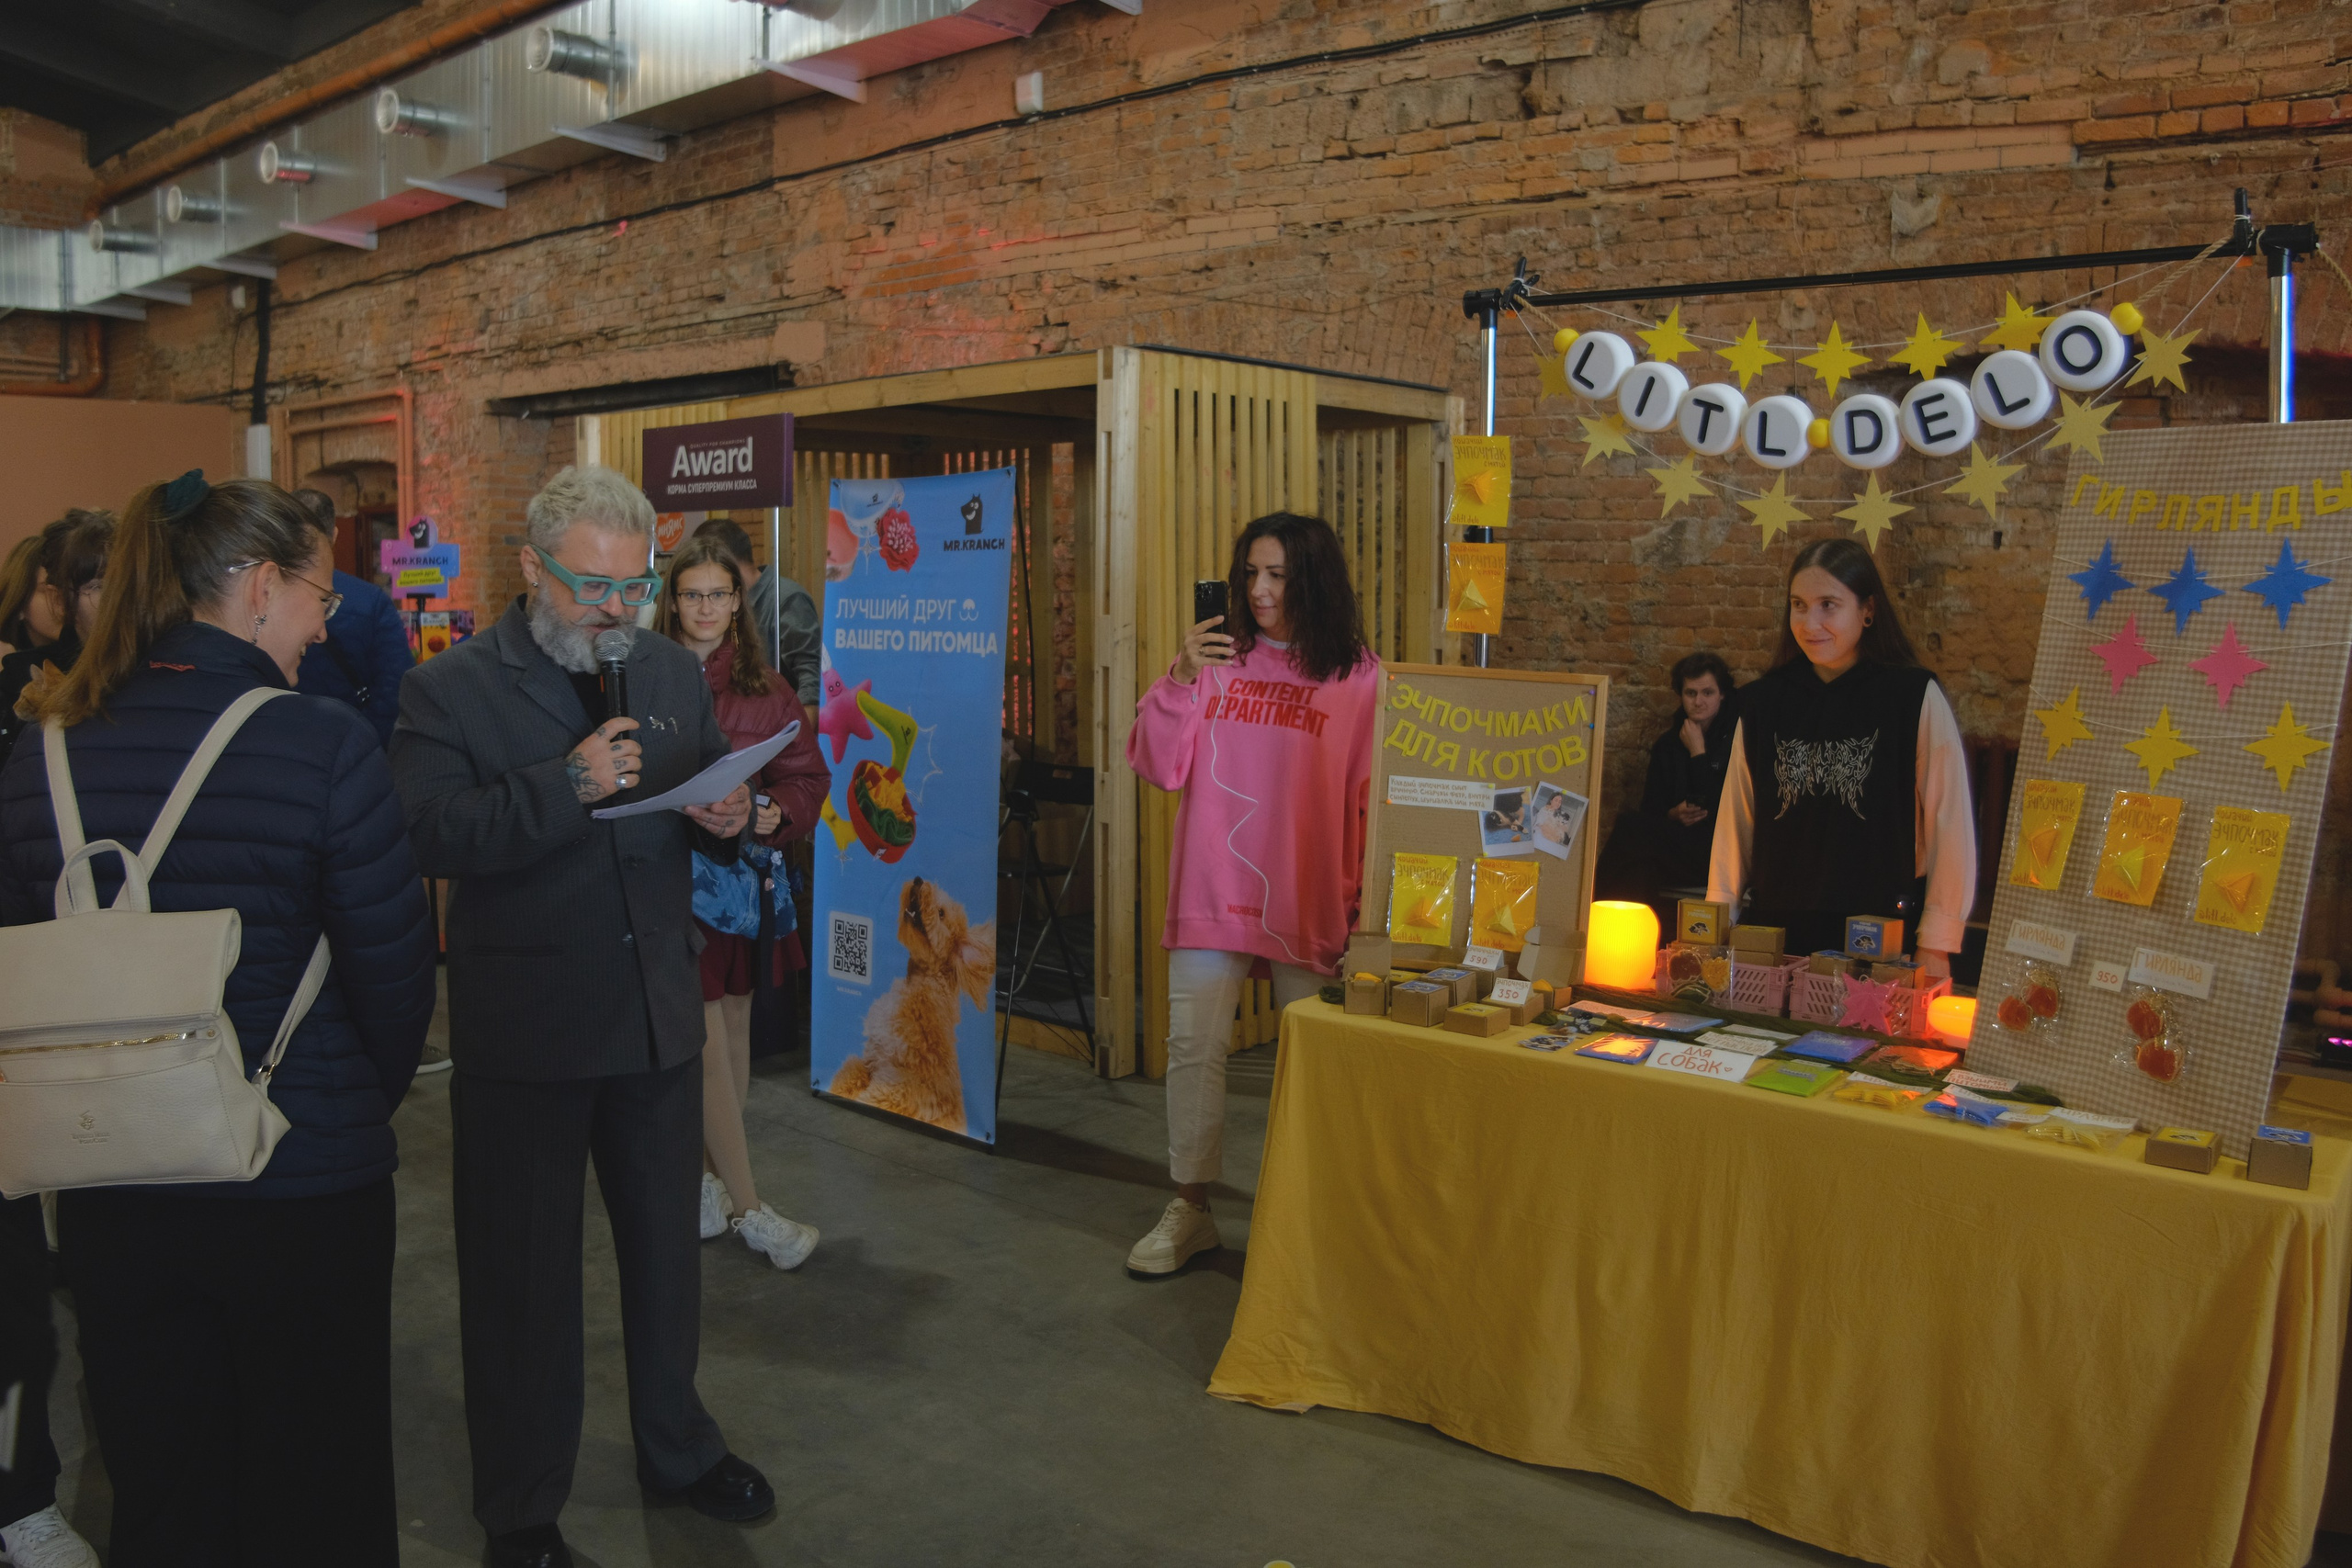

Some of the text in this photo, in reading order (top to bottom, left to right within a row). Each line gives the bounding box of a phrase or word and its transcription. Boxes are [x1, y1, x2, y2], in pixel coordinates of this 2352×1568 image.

[1572, 324, 2104, 457] LITL DELO
[671, 435, 753, 478] Award
[668, 479, 758, 495] КОРМА СУПЕРПРЕМИУМ КЛАССА
[2070, 469, 2352, 535] ГИРЛЯНДЫ
[944, 538, 1005, 551] MR.KRANCH
[392, 556, 448, 566] MR.KRANCH
[835, 594, 956, 624] ЛУЧШИЙ ДРУГ
[835, 628, 999, 657] ВАШЕГО ПИТОМЦА
[1227, 678, 1318, 705] CONTENT
[1204, 695, 1329, 738] DEPARTMENT
[1391, 683, 1589, 738] ЭЧПОЧМАКИ
[1383, 718, 1588, 781] ДЛЯ КОТОВ
[1469, 954, 1487, 964] 590
[2096, 970, 2119, 985] 950
[1498, 988, 1519, 999] 350
[1680, 1046, 1713, 1060] ДЛЯ
